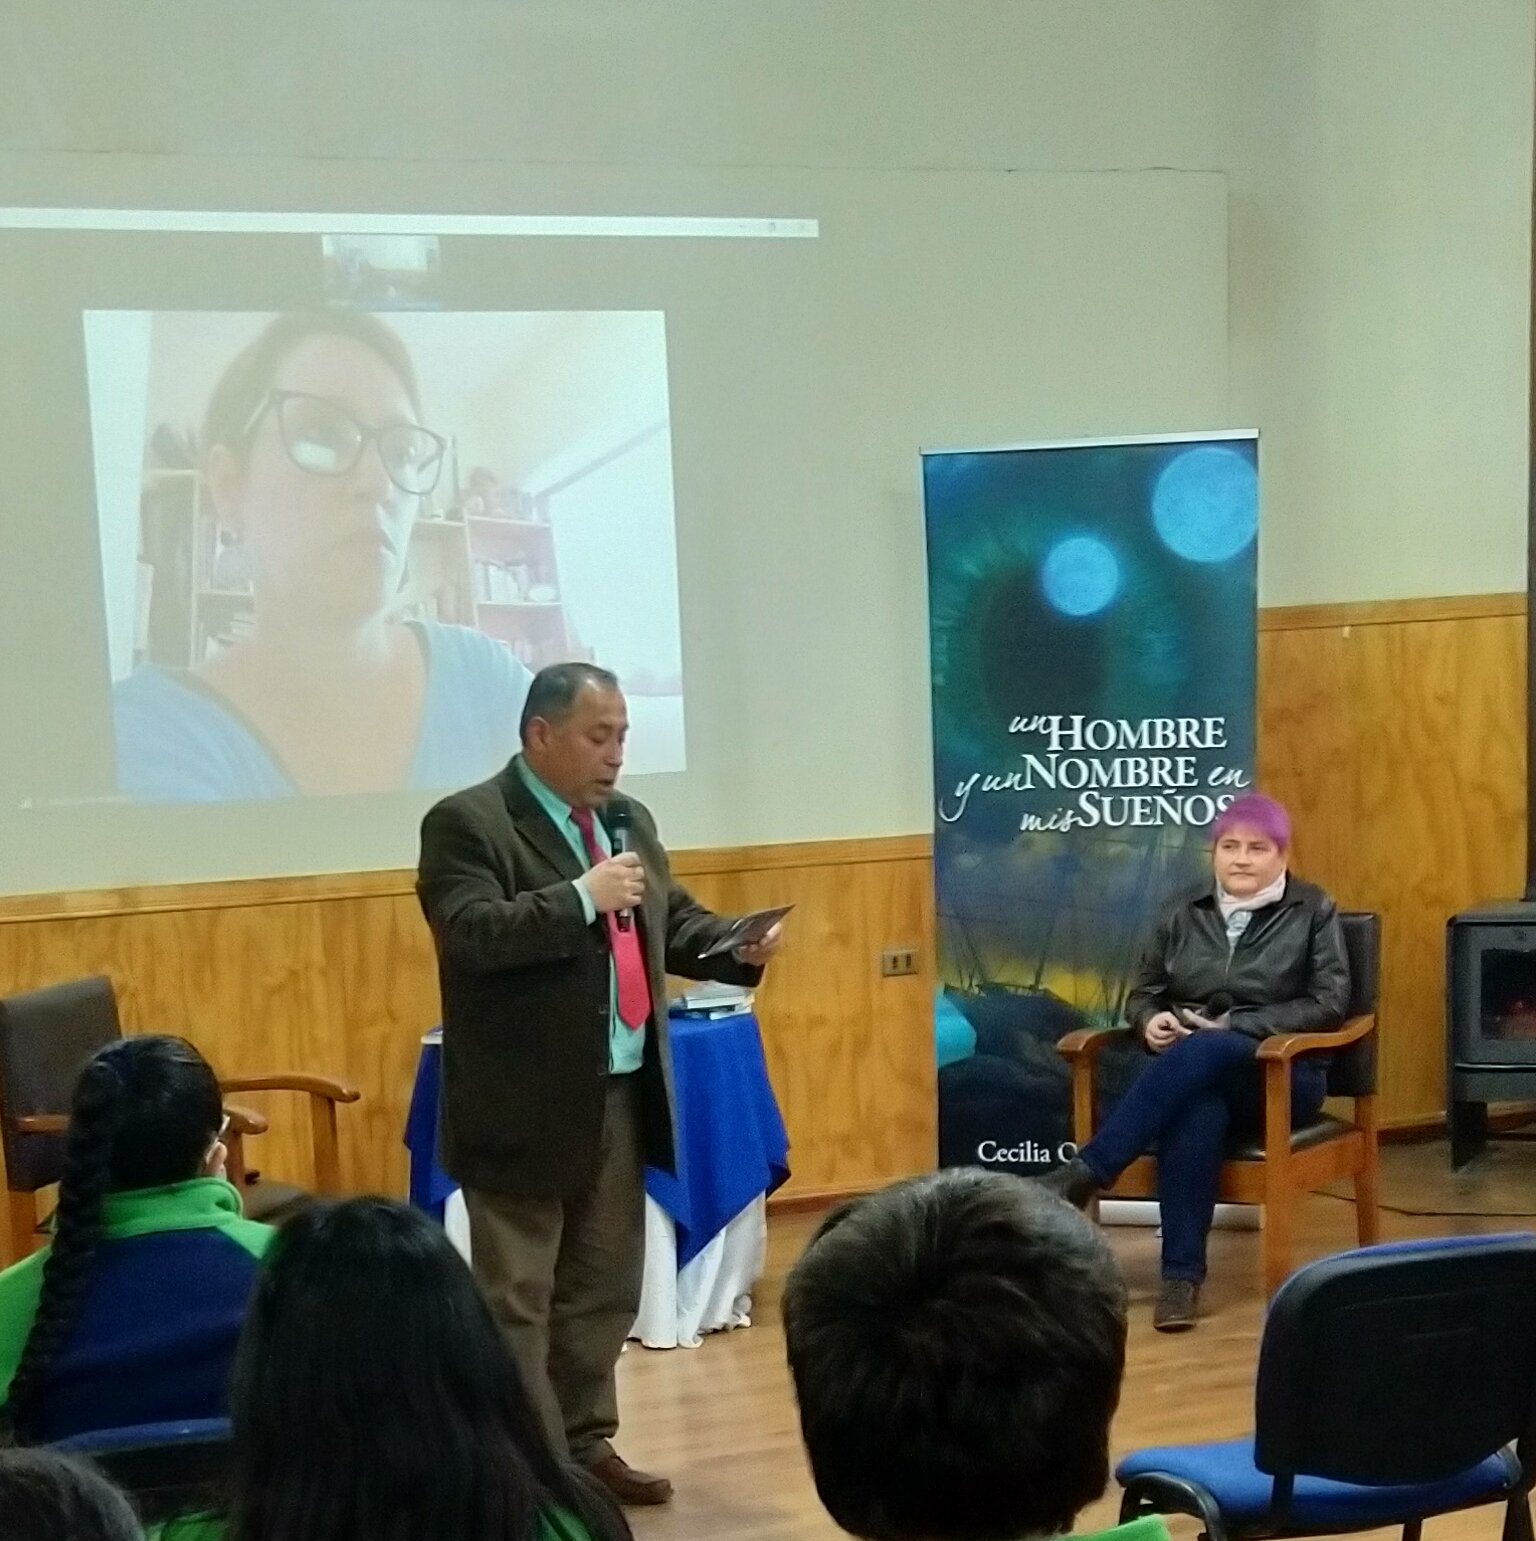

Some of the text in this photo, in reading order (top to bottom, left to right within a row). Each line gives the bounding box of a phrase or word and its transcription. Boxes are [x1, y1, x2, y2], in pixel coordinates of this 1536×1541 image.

[1008, 711, 1228, 752] un HOMBRE
[938, 752, 1252, 823] y un NOMBRE en
[1020, 807, 1078, 832] mis
[978, 1141, 1052, 1163] Cecilia
